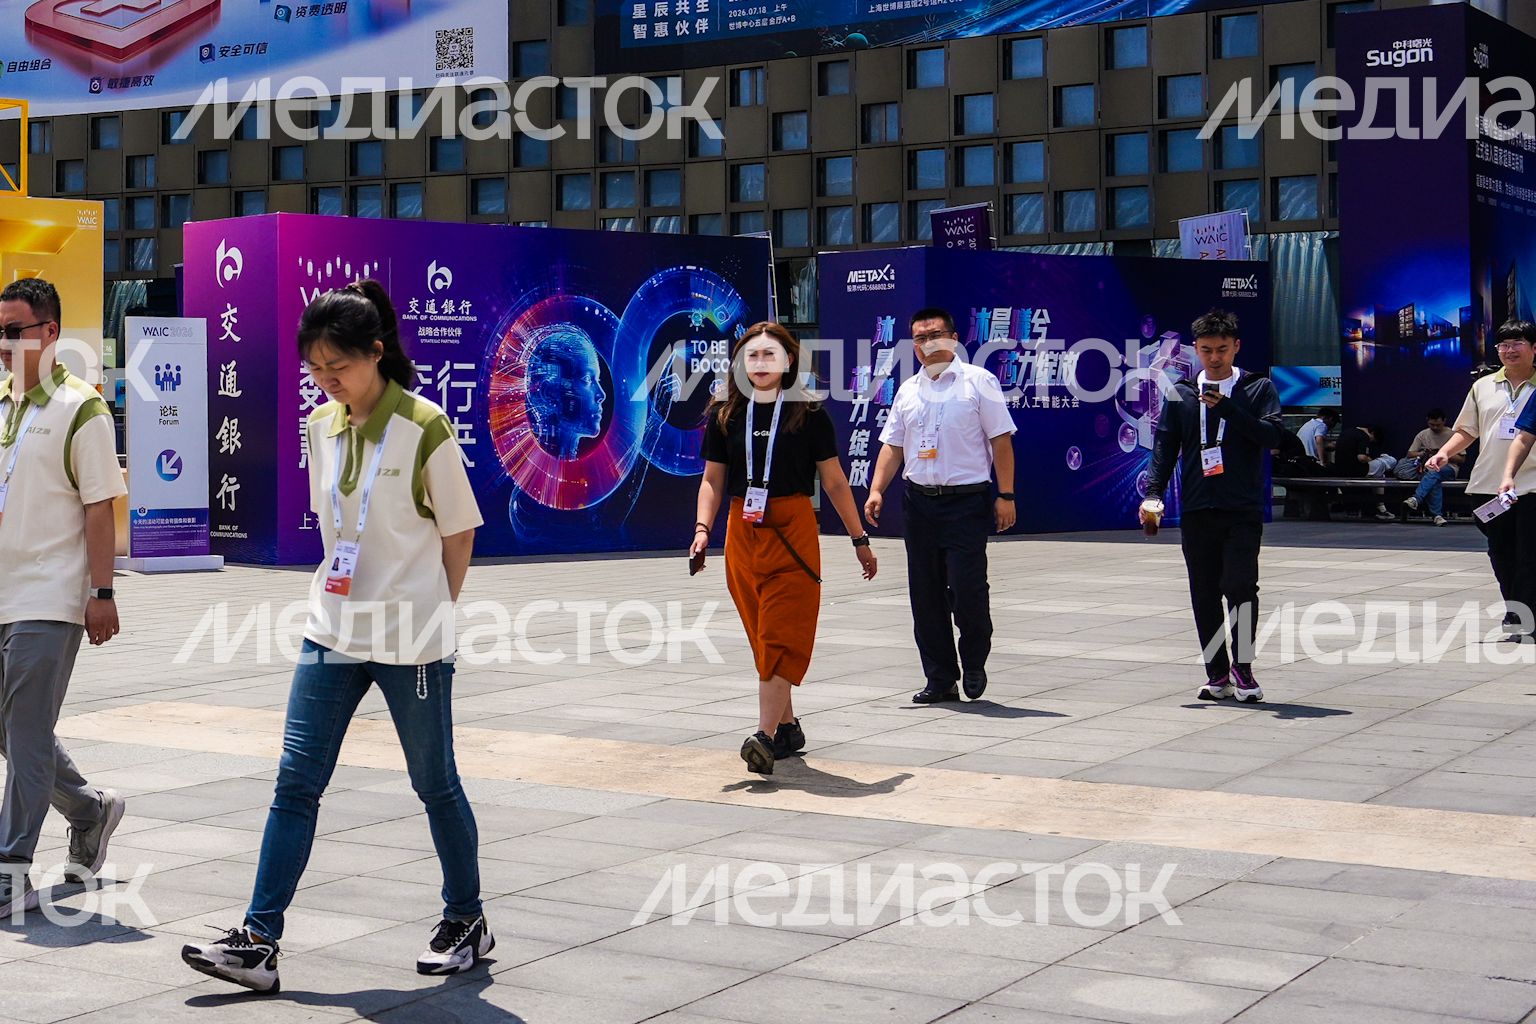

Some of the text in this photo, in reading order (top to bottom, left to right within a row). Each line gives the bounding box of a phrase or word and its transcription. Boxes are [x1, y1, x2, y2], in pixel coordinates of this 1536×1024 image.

[295, 1, 347, 20] 资费透明
[728, 3, 788, 18] 2026.07.18 上午
[632, 18, 710, 40] 智惠伙伴
[218, 41, 269, 58] 安全可信
[6, 57, 52, 74] 自由组合
[1365, 48, 1434, 68] Sugon
[107, 74, 154, 90] 敏捷高效
[77, 216, 97, 225] WAIC
[944, 224, 975, 236] WAIC
[1194, 233, 1228, 245] WAIC
[847, 264, 891, 283] METAX
[1222, 274, 1254, 289] METAX
[407, 297, 473, 316] 交通銀行
[417, 326, 462, 338] 战略合作伙伴
[691, 339, 726, 355] TO BE
[691, 358, 734, 374] BOCO
[159, 405, 178, 417] 论坛
[215, 304, 243, 512] 交通銀行
[158, 418, 179, 426] Forum
[209, 531, 248, 539] COMMUNICATIONS
